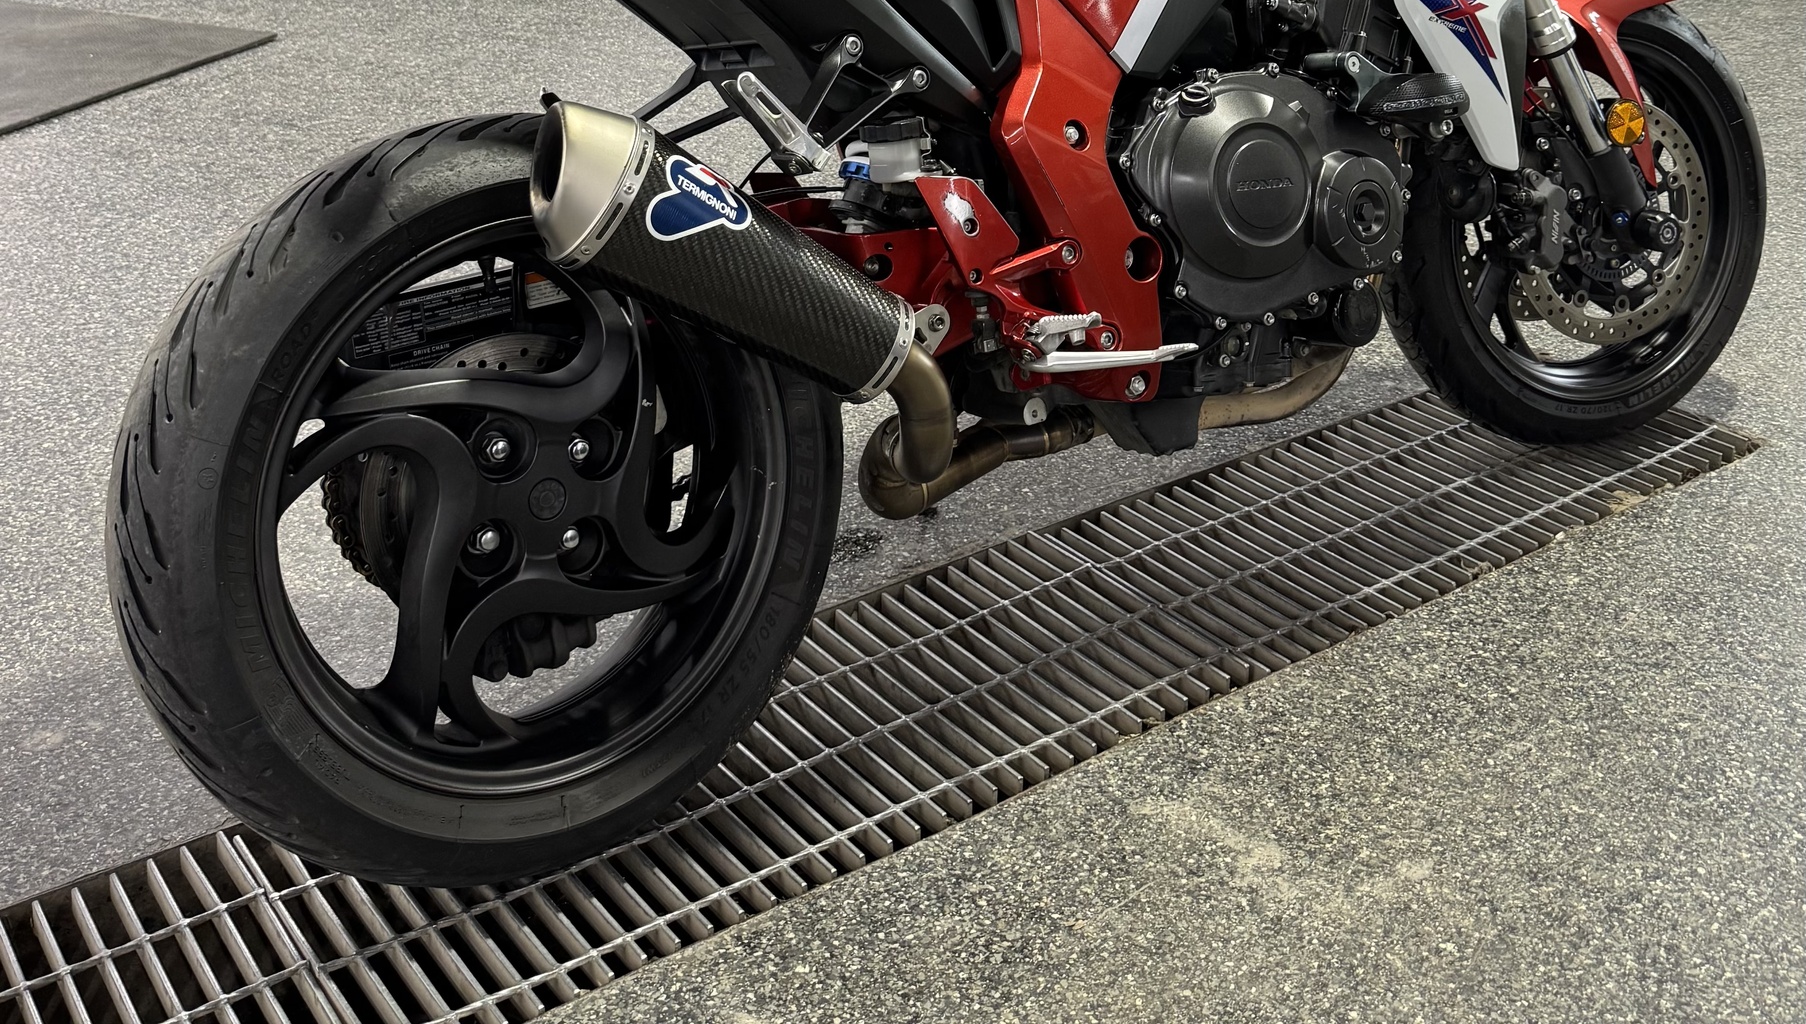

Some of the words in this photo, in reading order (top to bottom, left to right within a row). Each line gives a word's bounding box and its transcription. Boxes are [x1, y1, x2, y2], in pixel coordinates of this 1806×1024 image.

[1428, 15, 1467, 33] EXTREME
[677, 174, 737, 221] TERMIGNONI
[1236, 177, 1294, 192] HONDA
[270, 322, 317, 384] ROAD
[413, 347, 430, 356] DRIVE
[431, 343, 450, 352] CHAIN
[1628, 353, 1697, 407] MICHELIN
[1581, 403, 1613, 415] 120/70
[226, 419, 272, 675] MICHELIN
